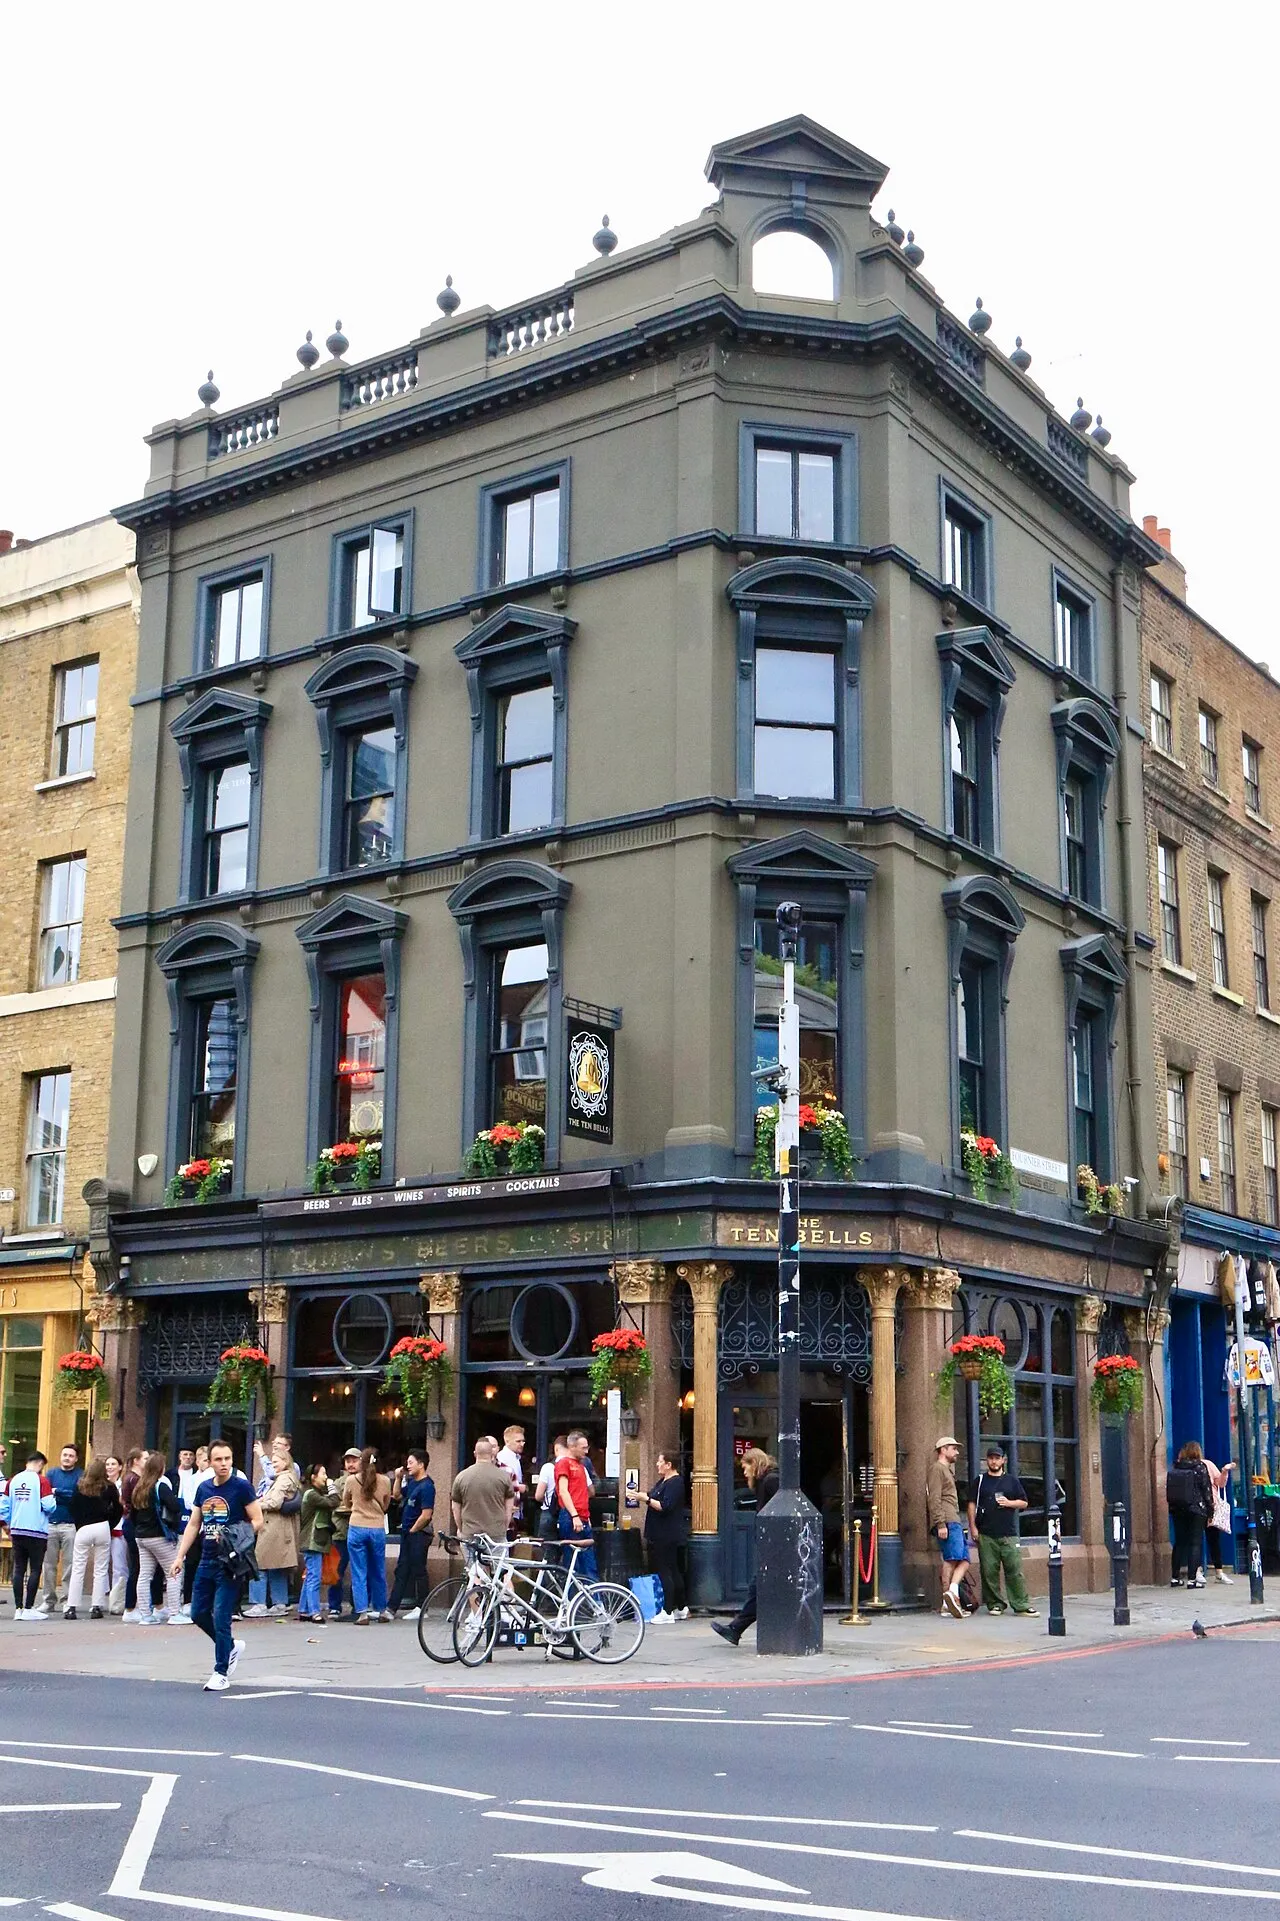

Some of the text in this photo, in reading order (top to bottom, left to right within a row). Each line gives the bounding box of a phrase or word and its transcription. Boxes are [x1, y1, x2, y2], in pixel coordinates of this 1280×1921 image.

[503, 1089, 545, 1112] OCKTAILS
[568, 1118, 609, 1134] THE TEN BELLS
[1012, 1151, 1061, 1174] FOURNIER STREET
[304, 1177, 560, 1210] BEERS ALES WINES SPIRITS COCKTAILS
[799, 1218, 820, 1228] HE
[417, 1232, 513, 1258] BEERS
[730, 1228, 873, 1245] TEN BELLS
